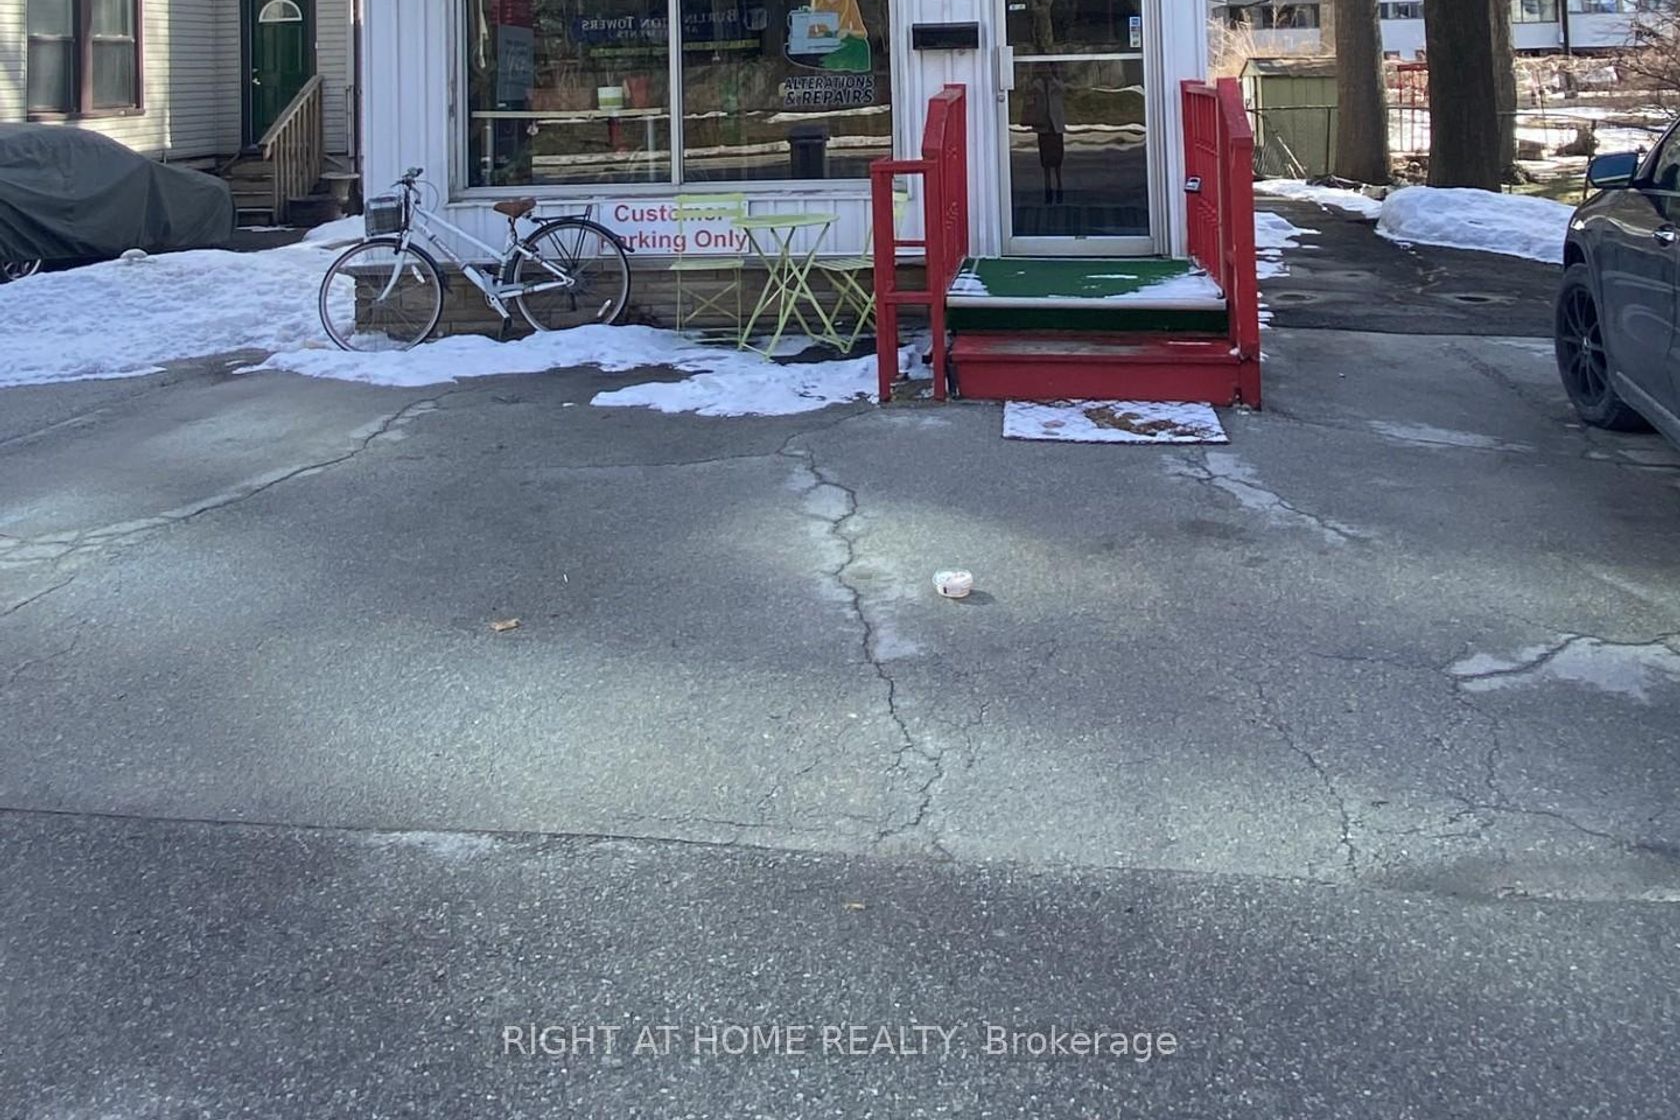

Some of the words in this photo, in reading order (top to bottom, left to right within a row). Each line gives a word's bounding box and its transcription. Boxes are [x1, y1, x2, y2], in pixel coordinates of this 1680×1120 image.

[784, 75, 875, 90] ALTERATIONS
[784, 90, 798, 106] &
[801, 87, 874, 105] REPAIRS
[695, 229, 747, 251] Only
